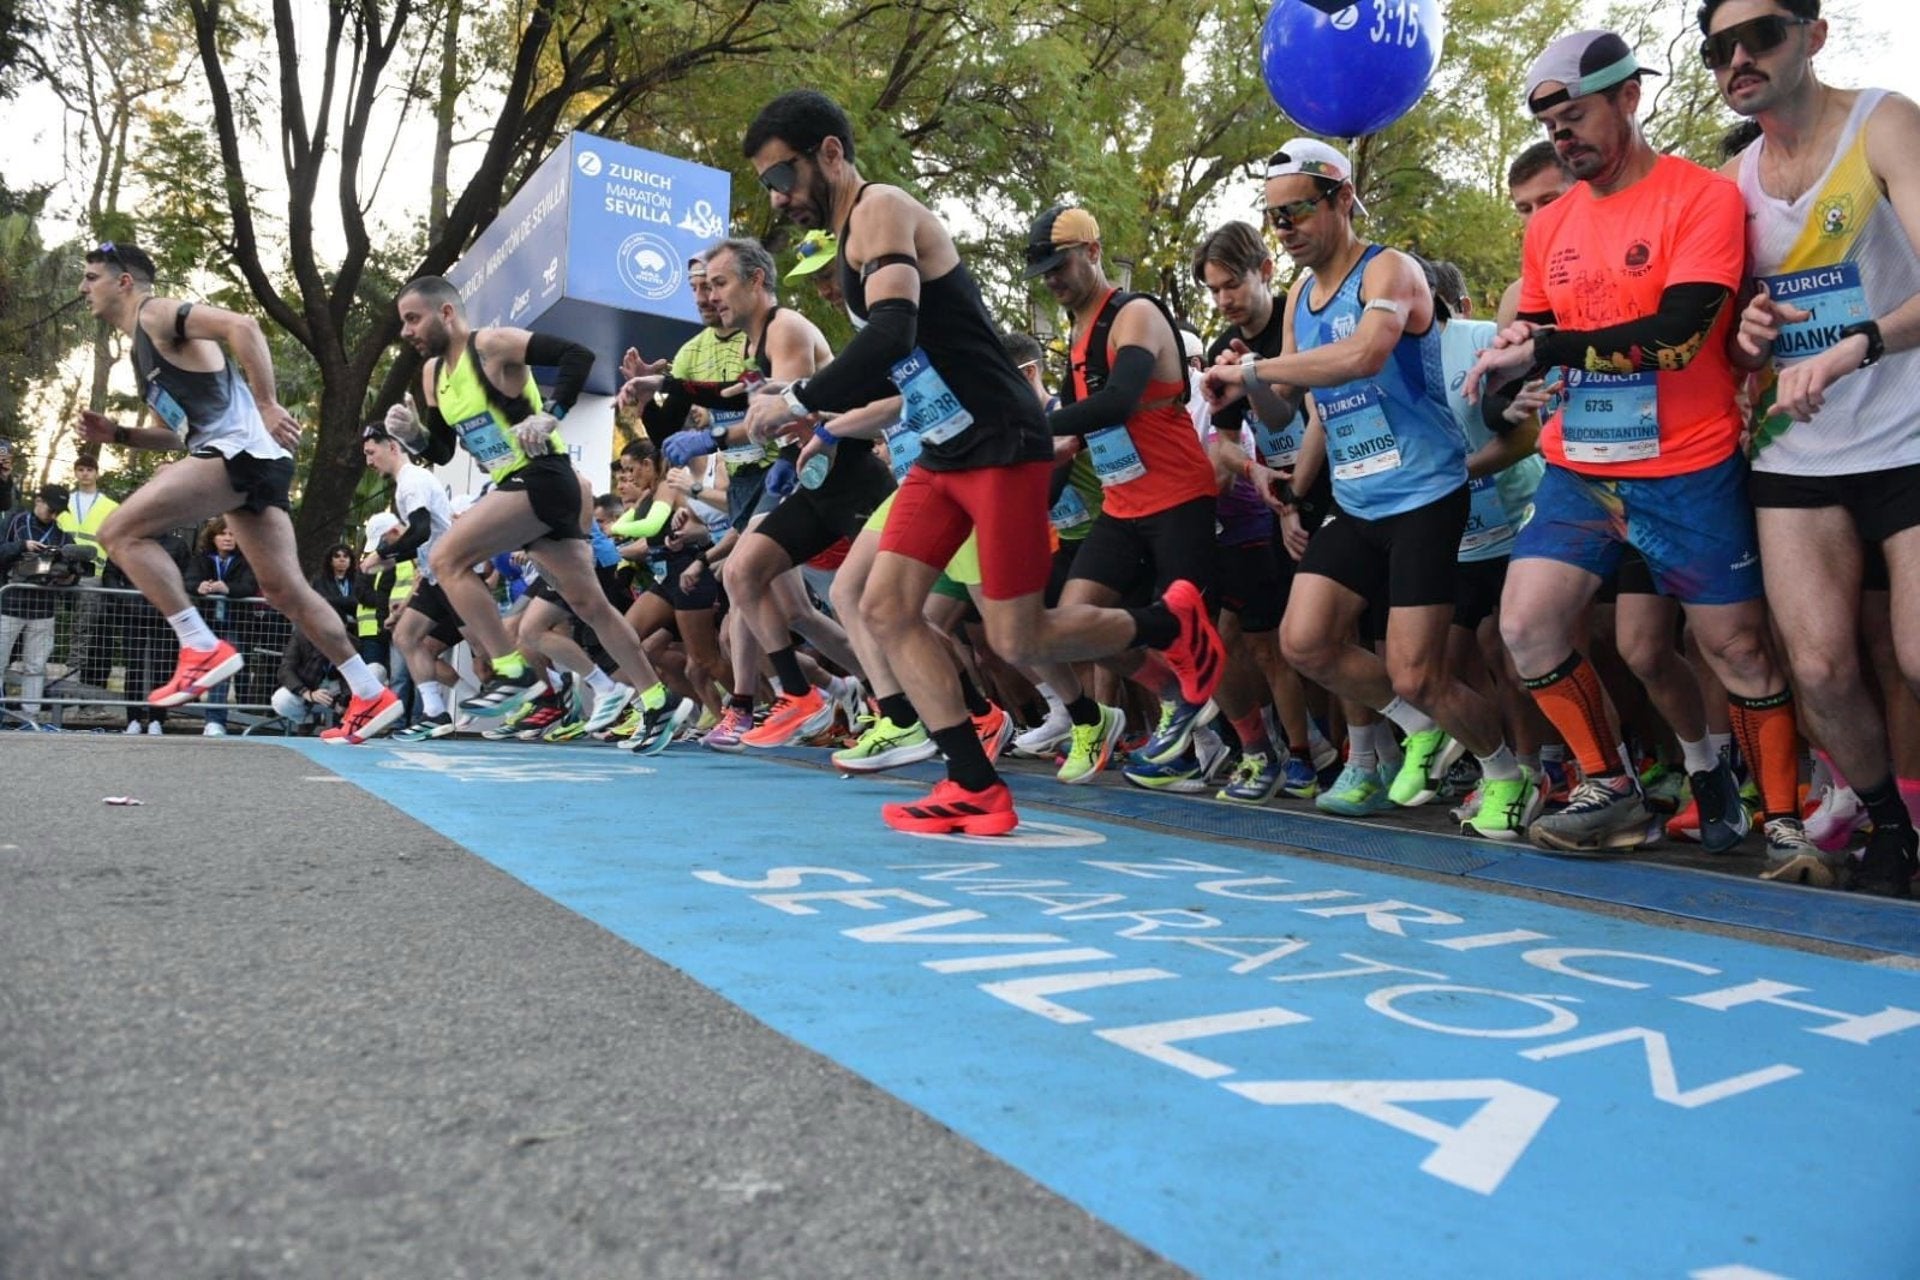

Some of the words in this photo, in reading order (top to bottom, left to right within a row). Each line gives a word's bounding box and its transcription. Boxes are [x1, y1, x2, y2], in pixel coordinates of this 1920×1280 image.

[1370, 0, 1418, 48] 3:15
[608, 163, 672, 190] ZURICH
[606, 182, 672, 209] MARATÓN
[605, 197, 672, 226] SEVILLA
[1776, 271, 1844, 296] ZURICH
[1326, 394, 1367, 415] ZURICH
[1585, 400, 1613, 412] 6735
[1269, 435, 1294, 451] NICO
[1347, 434, 1395, 460] SANTOS
[1080, 858, 1920, 1044] ZURICH
[887, 863, 1804, 1108] MARATÓN
[691, 866, 1560, 1195] SEVILLA
